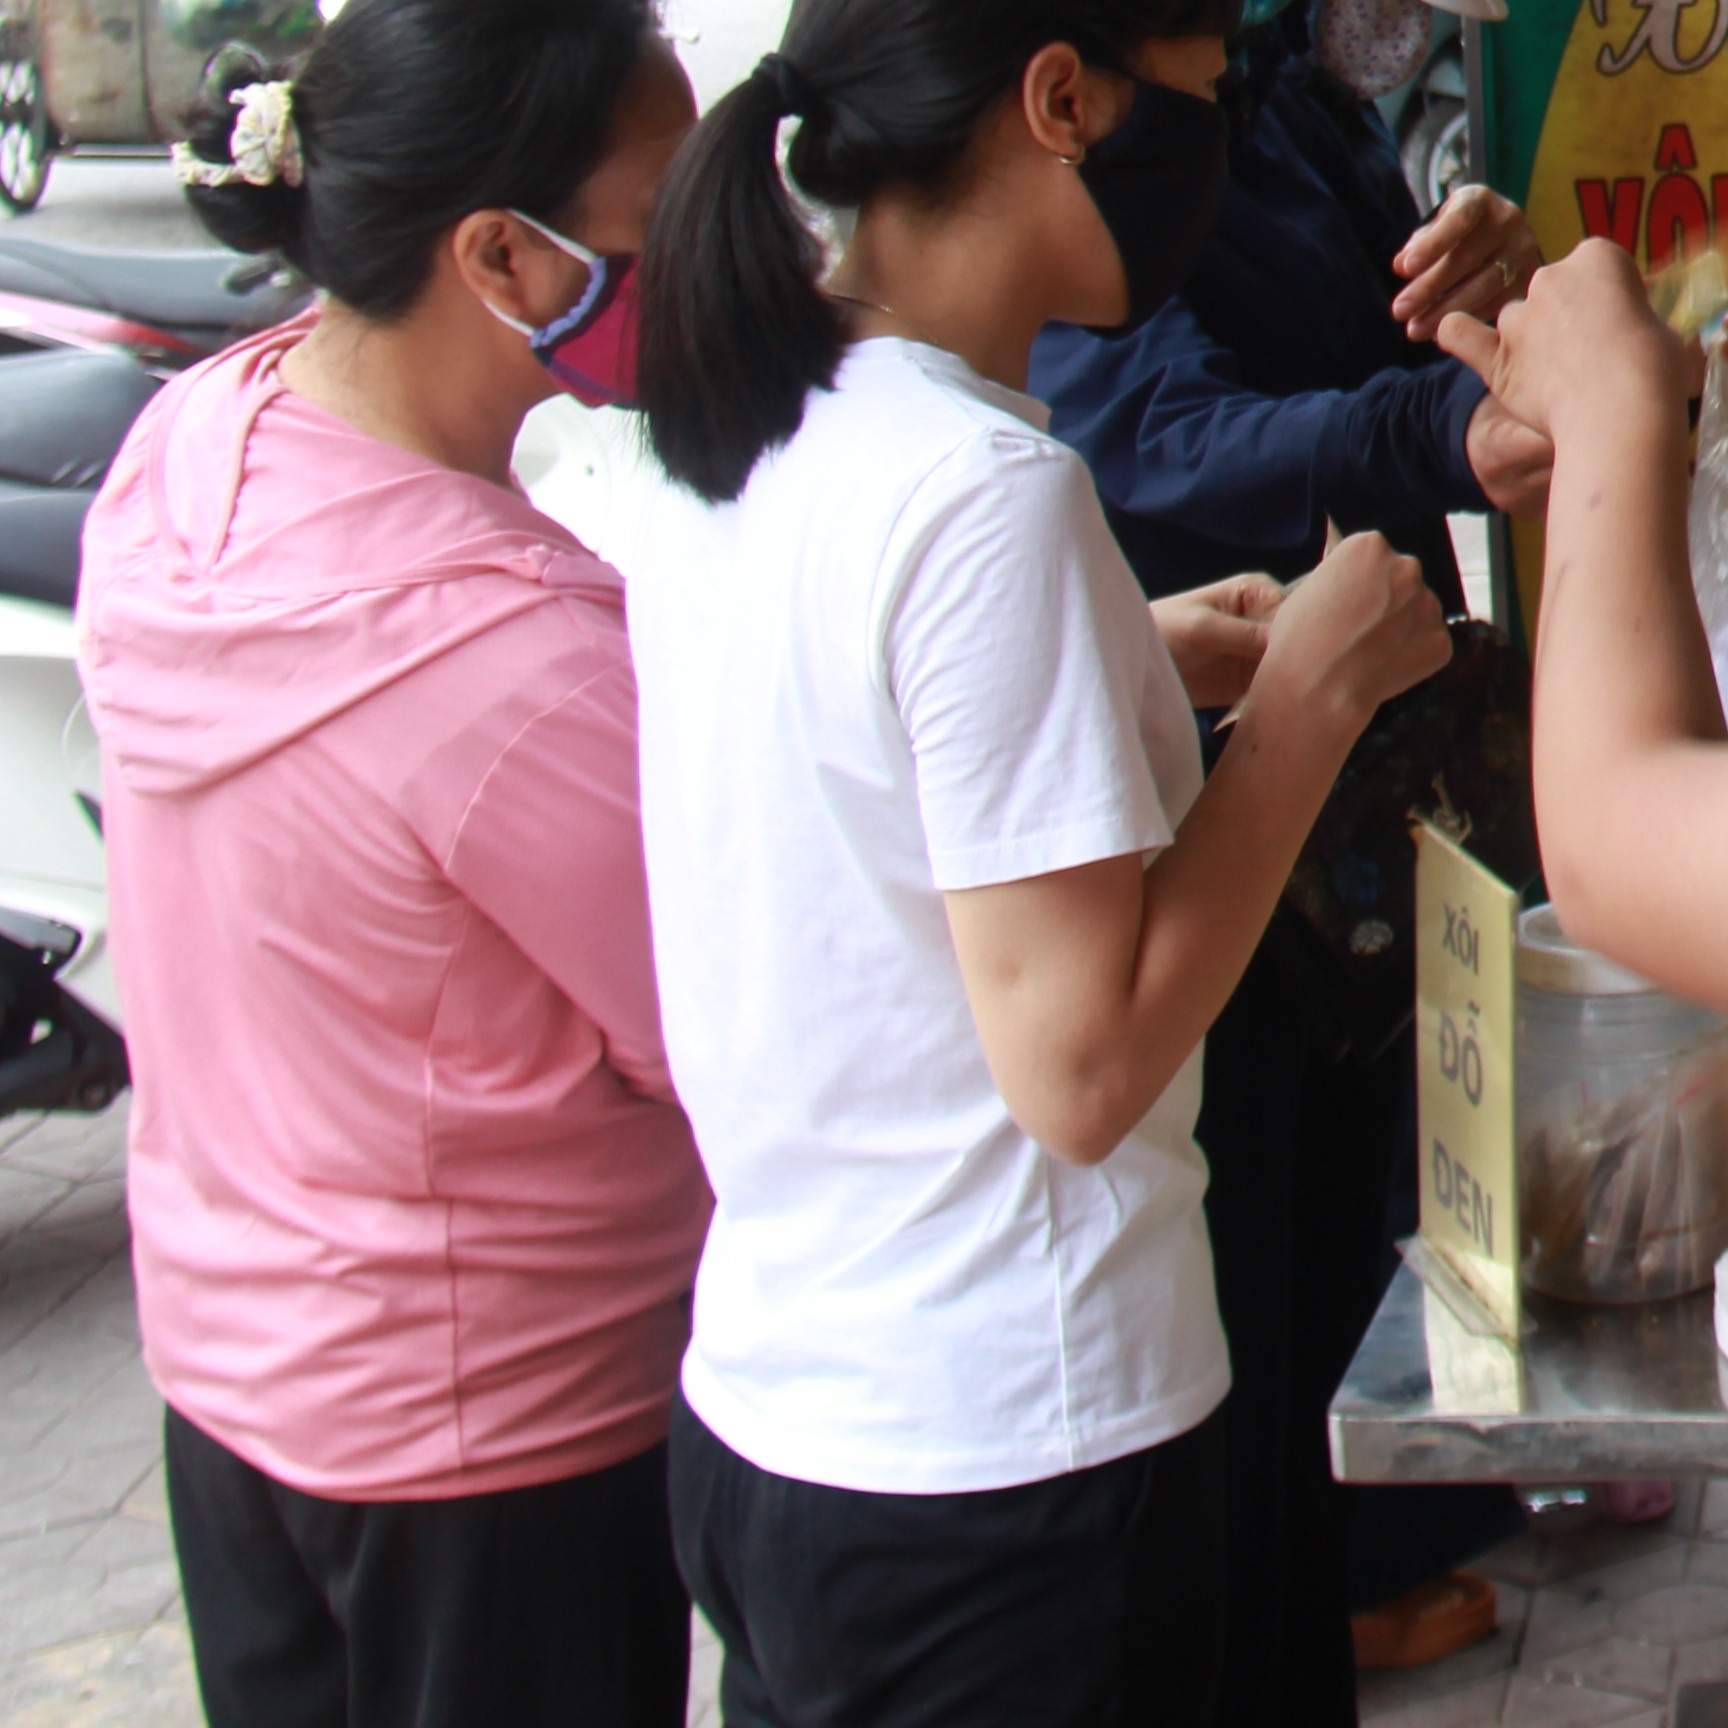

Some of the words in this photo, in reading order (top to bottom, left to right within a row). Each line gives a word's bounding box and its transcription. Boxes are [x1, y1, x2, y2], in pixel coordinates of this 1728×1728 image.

[1442, 902, 1480, 976] XÔI
[1440, 1000, 1484, 1108] ĐỖ
[1432, 1135, 1494, 1260] ĐEN
